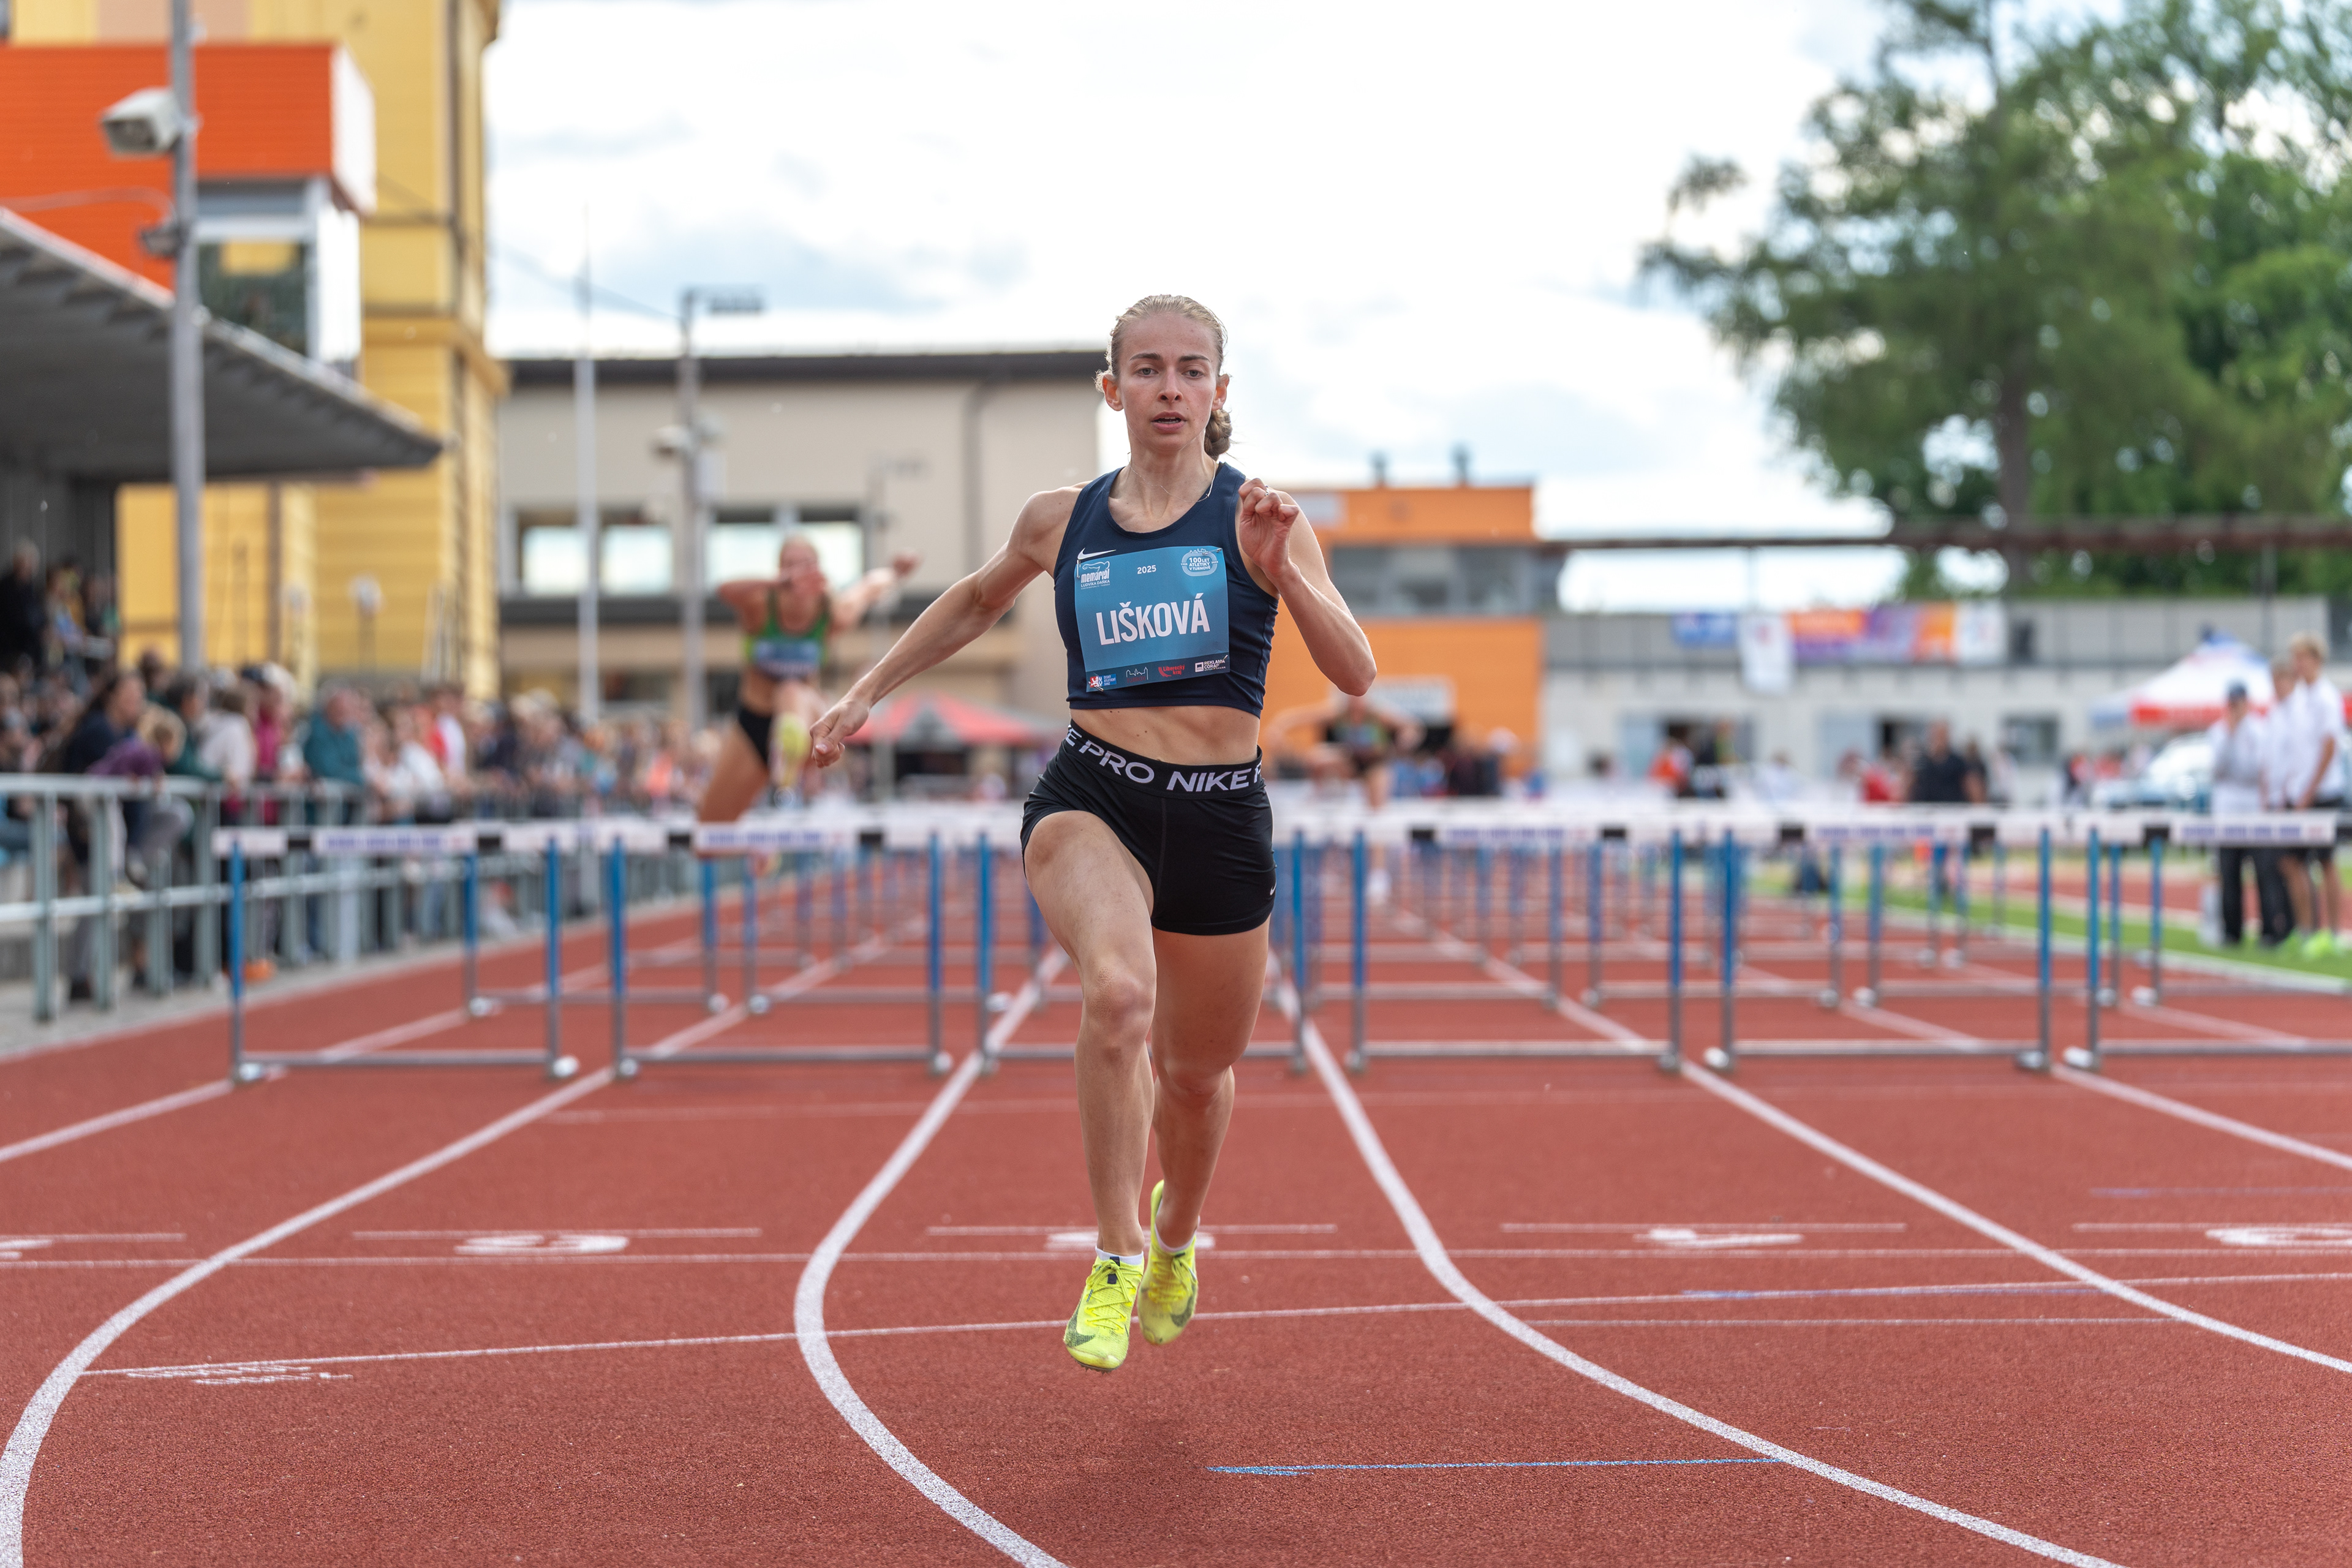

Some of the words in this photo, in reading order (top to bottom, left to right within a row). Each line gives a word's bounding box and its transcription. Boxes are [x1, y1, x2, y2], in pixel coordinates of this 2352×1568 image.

[1137, 565, 1157, 575] 2025
[1096, 592, 1210, 645] LIŠKOVÁ
[1079, 739, 1155, 784] PRO
[1166, 767, 1252, 793] NIKE
